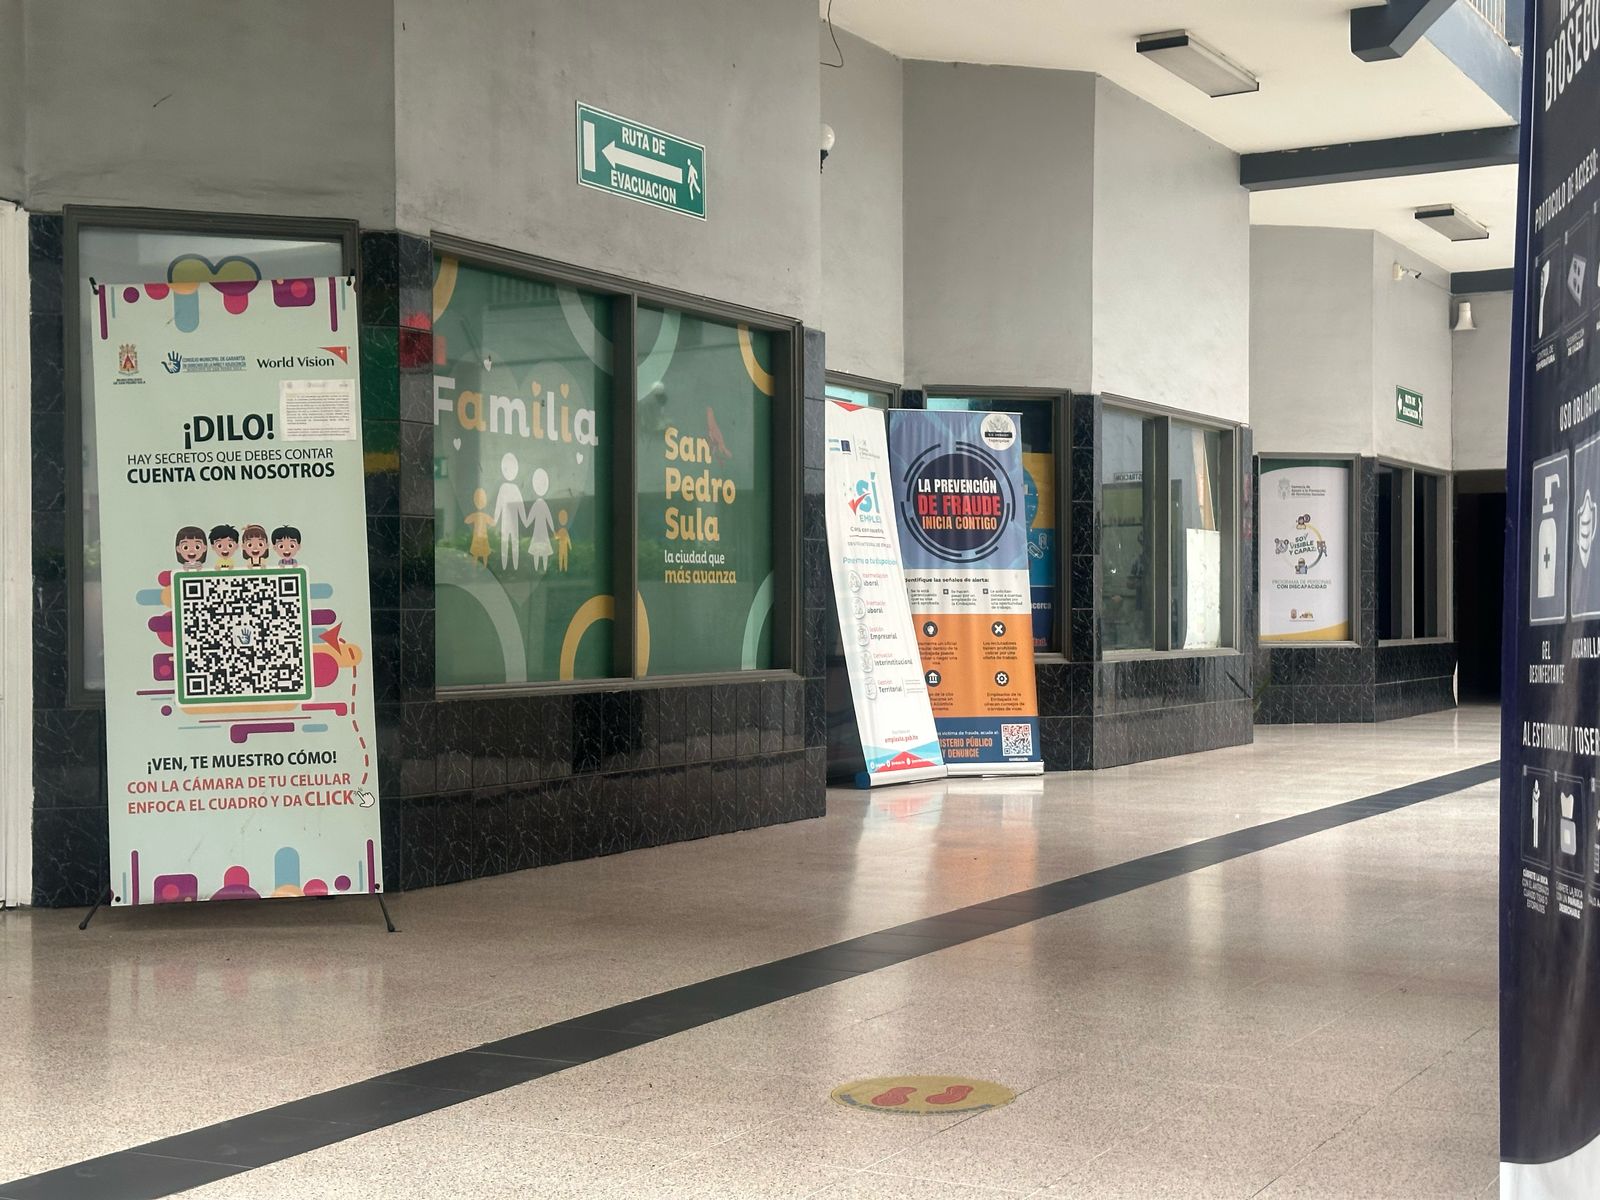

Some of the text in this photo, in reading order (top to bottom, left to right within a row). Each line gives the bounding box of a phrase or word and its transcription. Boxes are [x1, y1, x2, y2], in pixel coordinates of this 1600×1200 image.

[622, 126, 666, 156] RUTA DE
[611, 169, 677, 205] EVACUACION
[1535, 182, 1566, 234] PROTOCOLO
[1567, 172, 1574, 203] DE
[257, 357, 294, 369] World
[296, 356, 335, 368] Vision
[433, 374, 599, 447] Familia
[1560, 401, 1572, 432] USO
[183, 413, 275, 450] ¡DILO!
[664, 426, 712, 465] San
[127, 448, 334, 465] HAY SECRETOS QUE DEBES CONTAR
[127, 462, 335, 483] CUENTA CON NOSOTROS
[665, 467, 736, 506] Pedro
[918, 477, 997, 494] LA PREVENCIÓN
[918, 495, 1001, 516] DE FRAUDE
[665, 507, 720, 542] Sula
[860, 514, 881, 523] EMPLE
[922, 516, 998, 530] INICIA CONTIGO
[1290, 540, 1314, 549] VISIBLE
[1295, 533, 1309, 542] SOY
[664, 549, 725, 567] la ciudad que
[664, 567, 737, 584] más avanza
[1541, 640, 1551, 659] GEL
[1529, 665, 1565, 684] DESINFECTANTE
[966, 736, 993, 748] PÚBLICO
[1522, 721, 1531, 746] AL
[147, 749, 337, 774] ¡VEN, TE MUESTRO CÓMO!
[948, 748, 980, 758] DENUNCIE
[127, 773, 351, 794] CON LA CÁMARA DE TU CELULAR
[127, 789, 354, 815] ENFOCA EL CUADRO Y DA CLICK
